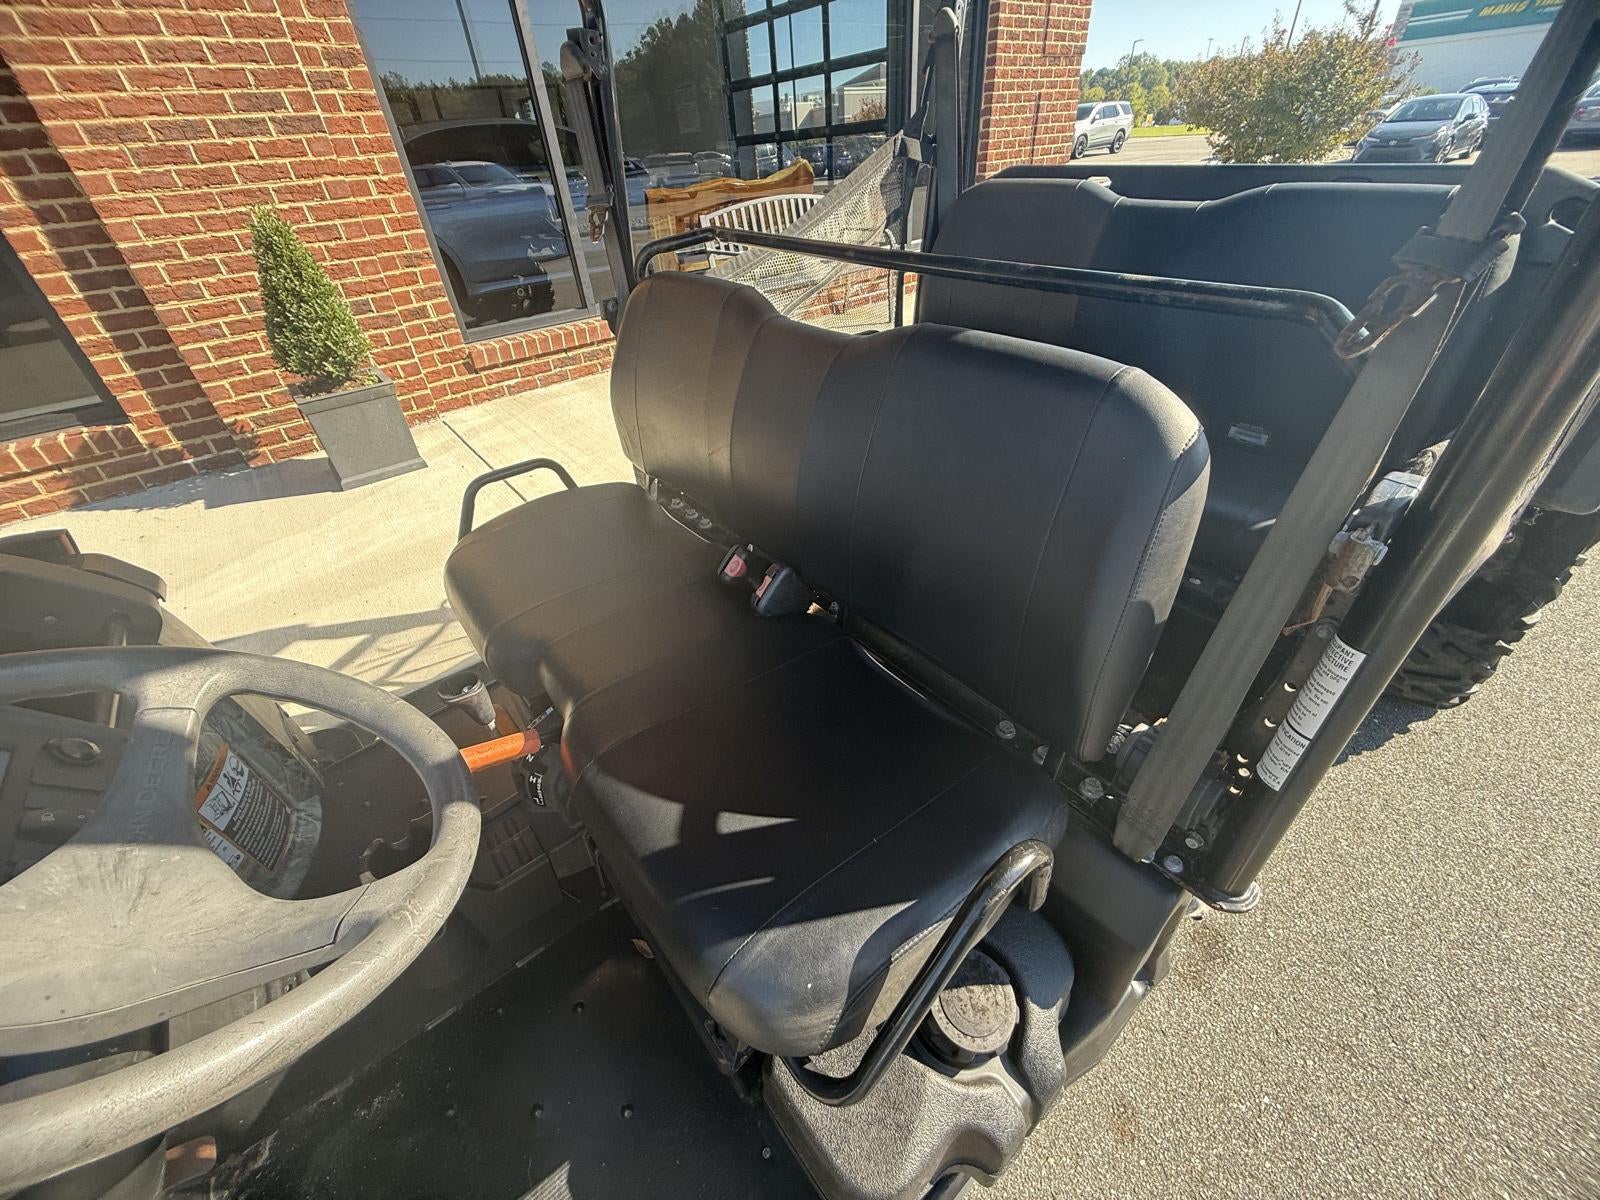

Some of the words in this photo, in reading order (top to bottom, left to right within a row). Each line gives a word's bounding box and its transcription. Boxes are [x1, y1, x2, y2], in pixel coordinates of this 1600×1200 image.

[1478, 1, 1530, 17] MAVIS
[1327, 644, 1354, 667] TECTIVE
[1330, 638, 1355, 659] CUPANT
